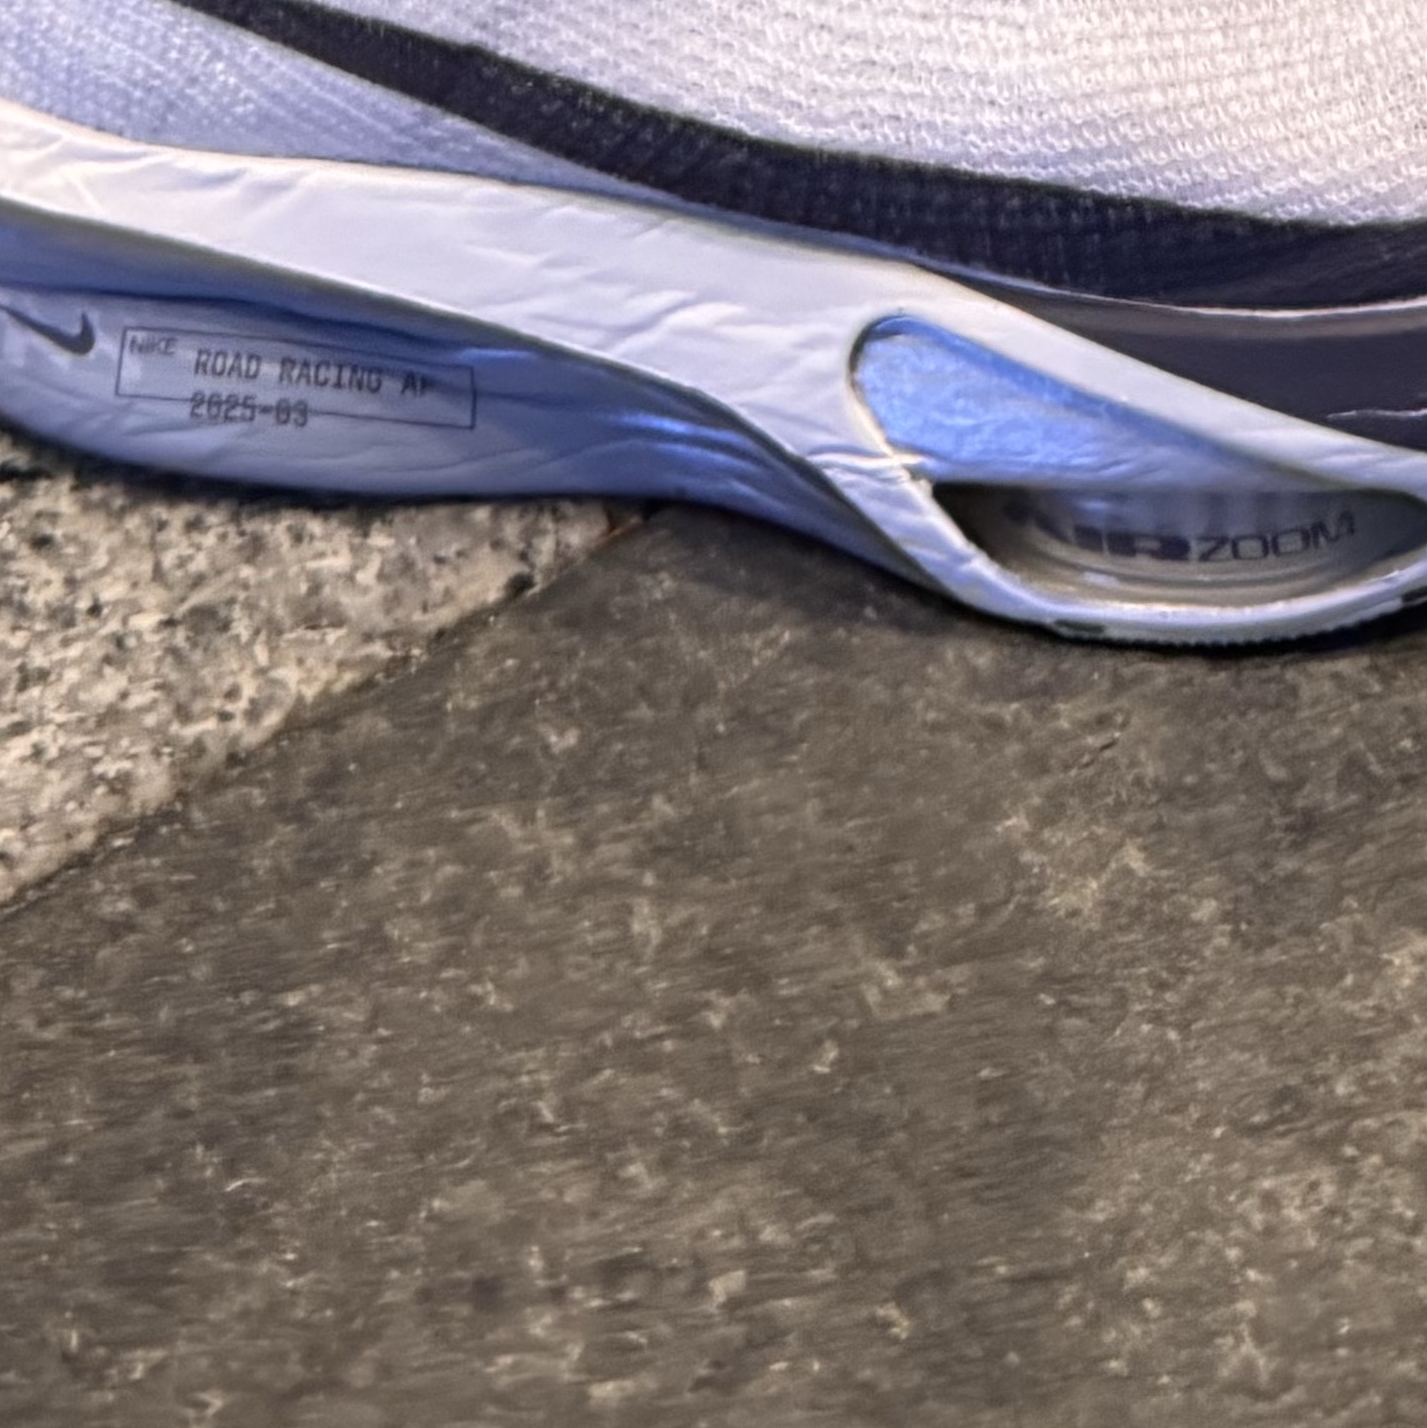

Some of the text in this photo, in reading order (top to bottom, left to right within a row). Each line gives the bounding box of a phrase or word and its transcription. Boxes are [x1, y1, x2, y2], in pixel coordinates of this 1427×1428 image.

[129, 334, 178, 357] NIKE
[193, 347, 263, 381] ROAD
[278, 356, 383, 393] RACING
[188, 390, 310, 428] 2025-03
[1196, 508, 1356, 562] ZOOM
